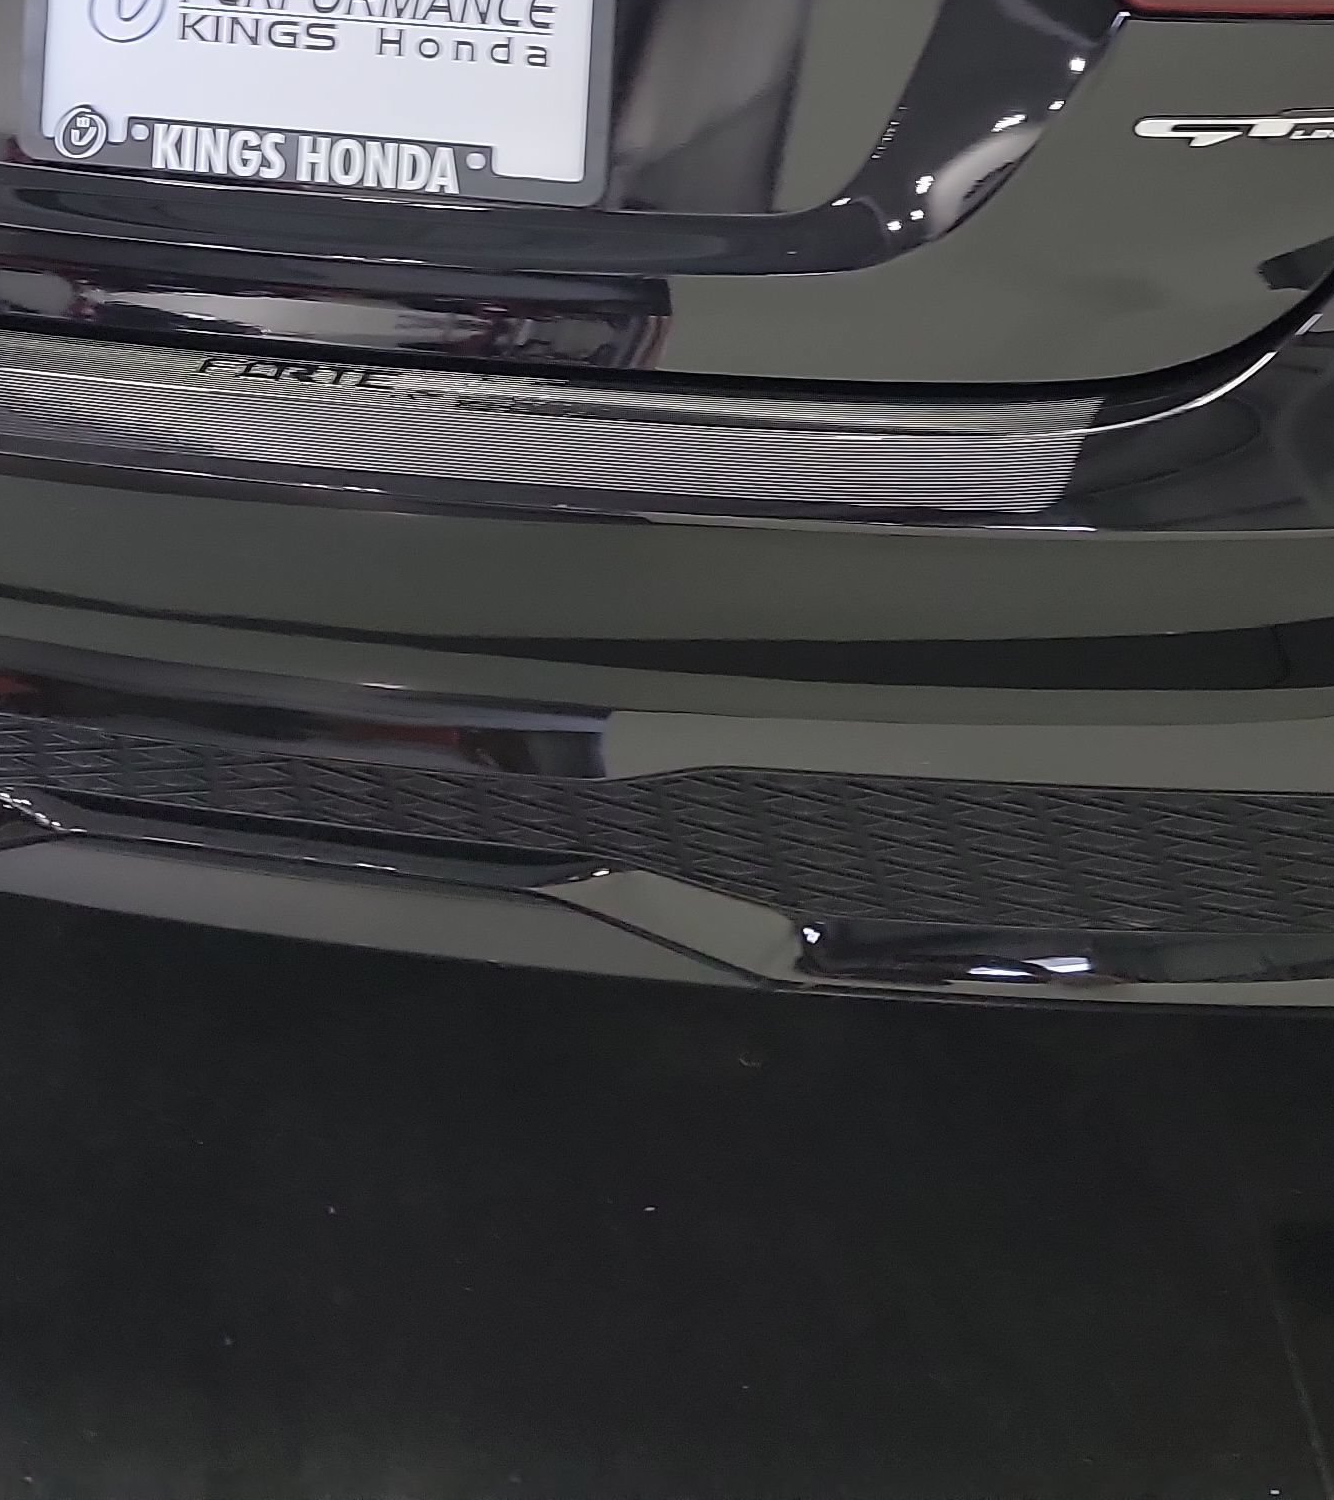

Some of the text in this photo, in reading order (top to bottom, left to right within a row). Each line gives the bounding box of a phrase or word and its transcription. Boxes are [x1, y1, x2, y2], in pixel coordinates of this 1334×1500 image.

[177, 11, 551, 68] KINGS Honda
[151, 122, 460, 195] KINGS HONDA
[196, 357, 401, 390] FORTE
